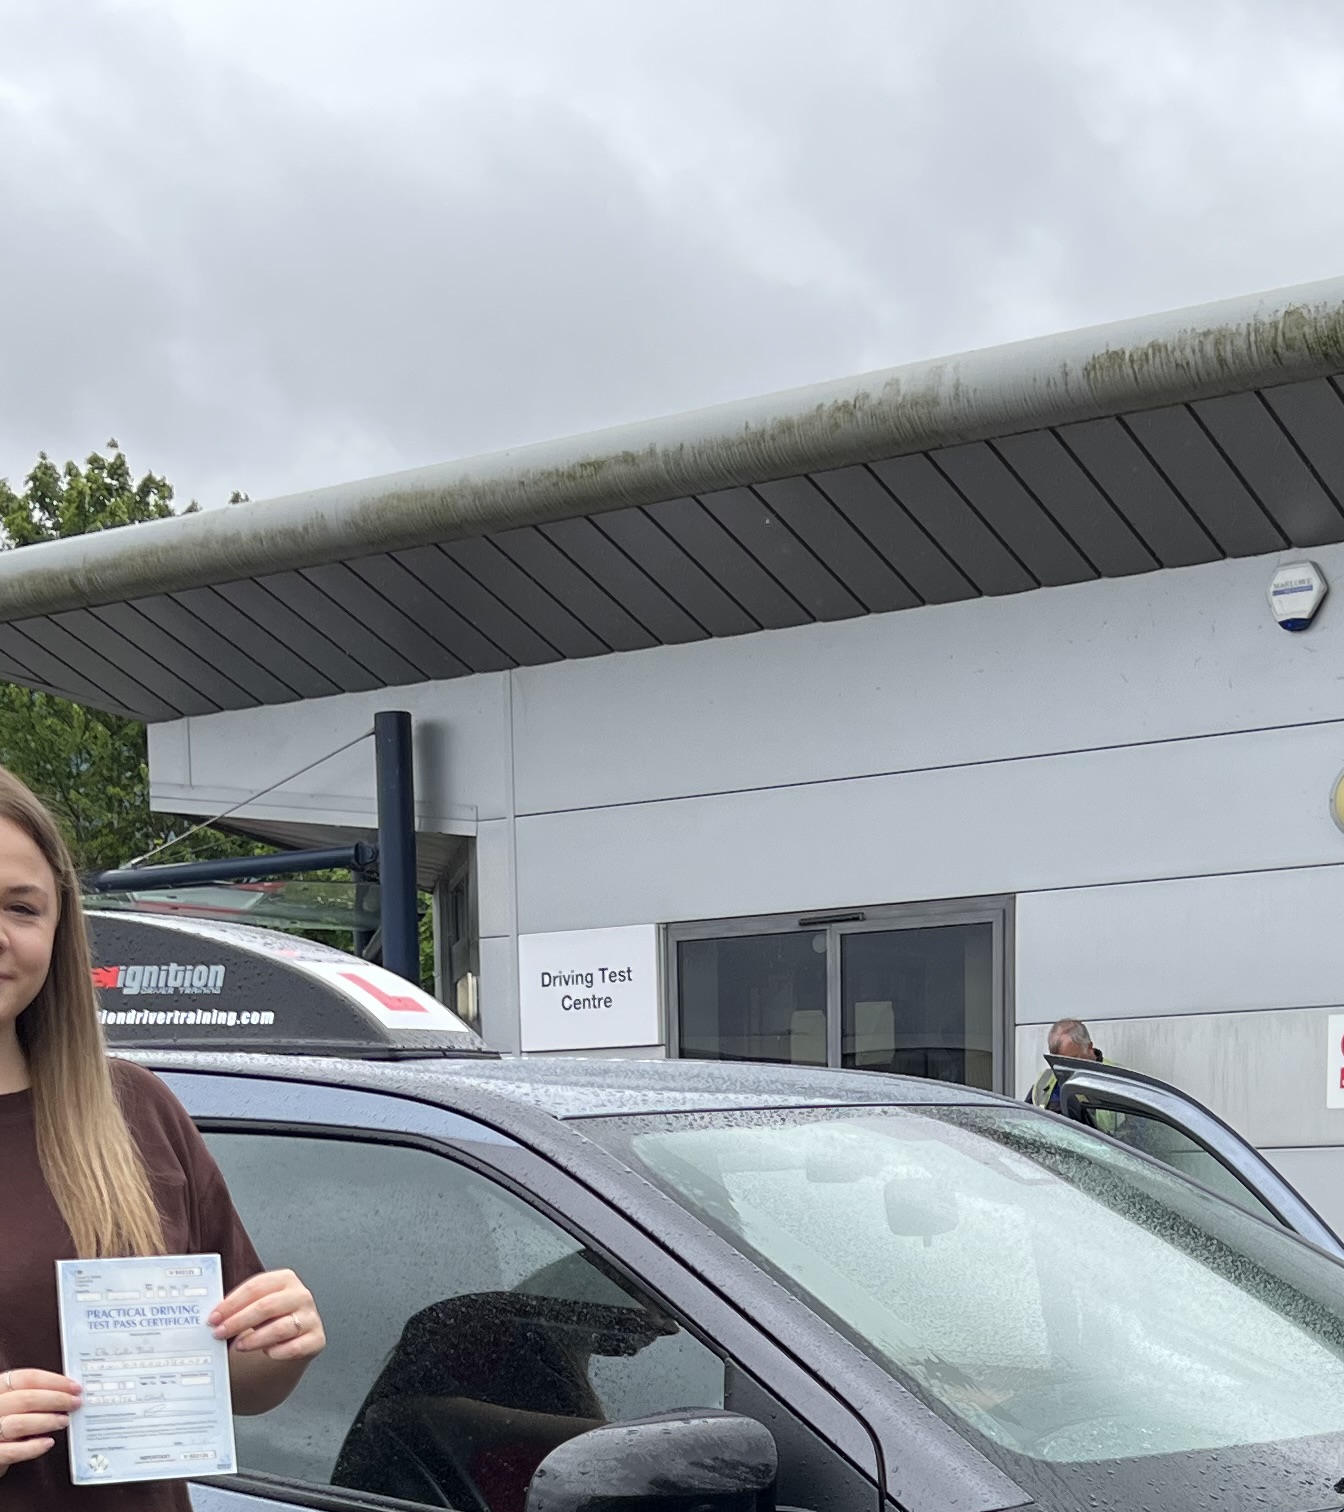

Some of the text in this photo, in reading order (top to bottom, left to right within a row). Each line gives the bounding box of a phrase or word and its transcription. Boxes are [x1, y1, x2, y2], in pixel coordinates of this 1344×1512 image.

[116, 962, 226, 995] ignition
[541, 966, 633, 989] Driving Test
[561, 994, 613, 1011] Centre
[86, 1304, 200, 1319] PRACTICAL DRIVING
[88, 1315, 201, 1330] TEST PASS CERTIFICATE
